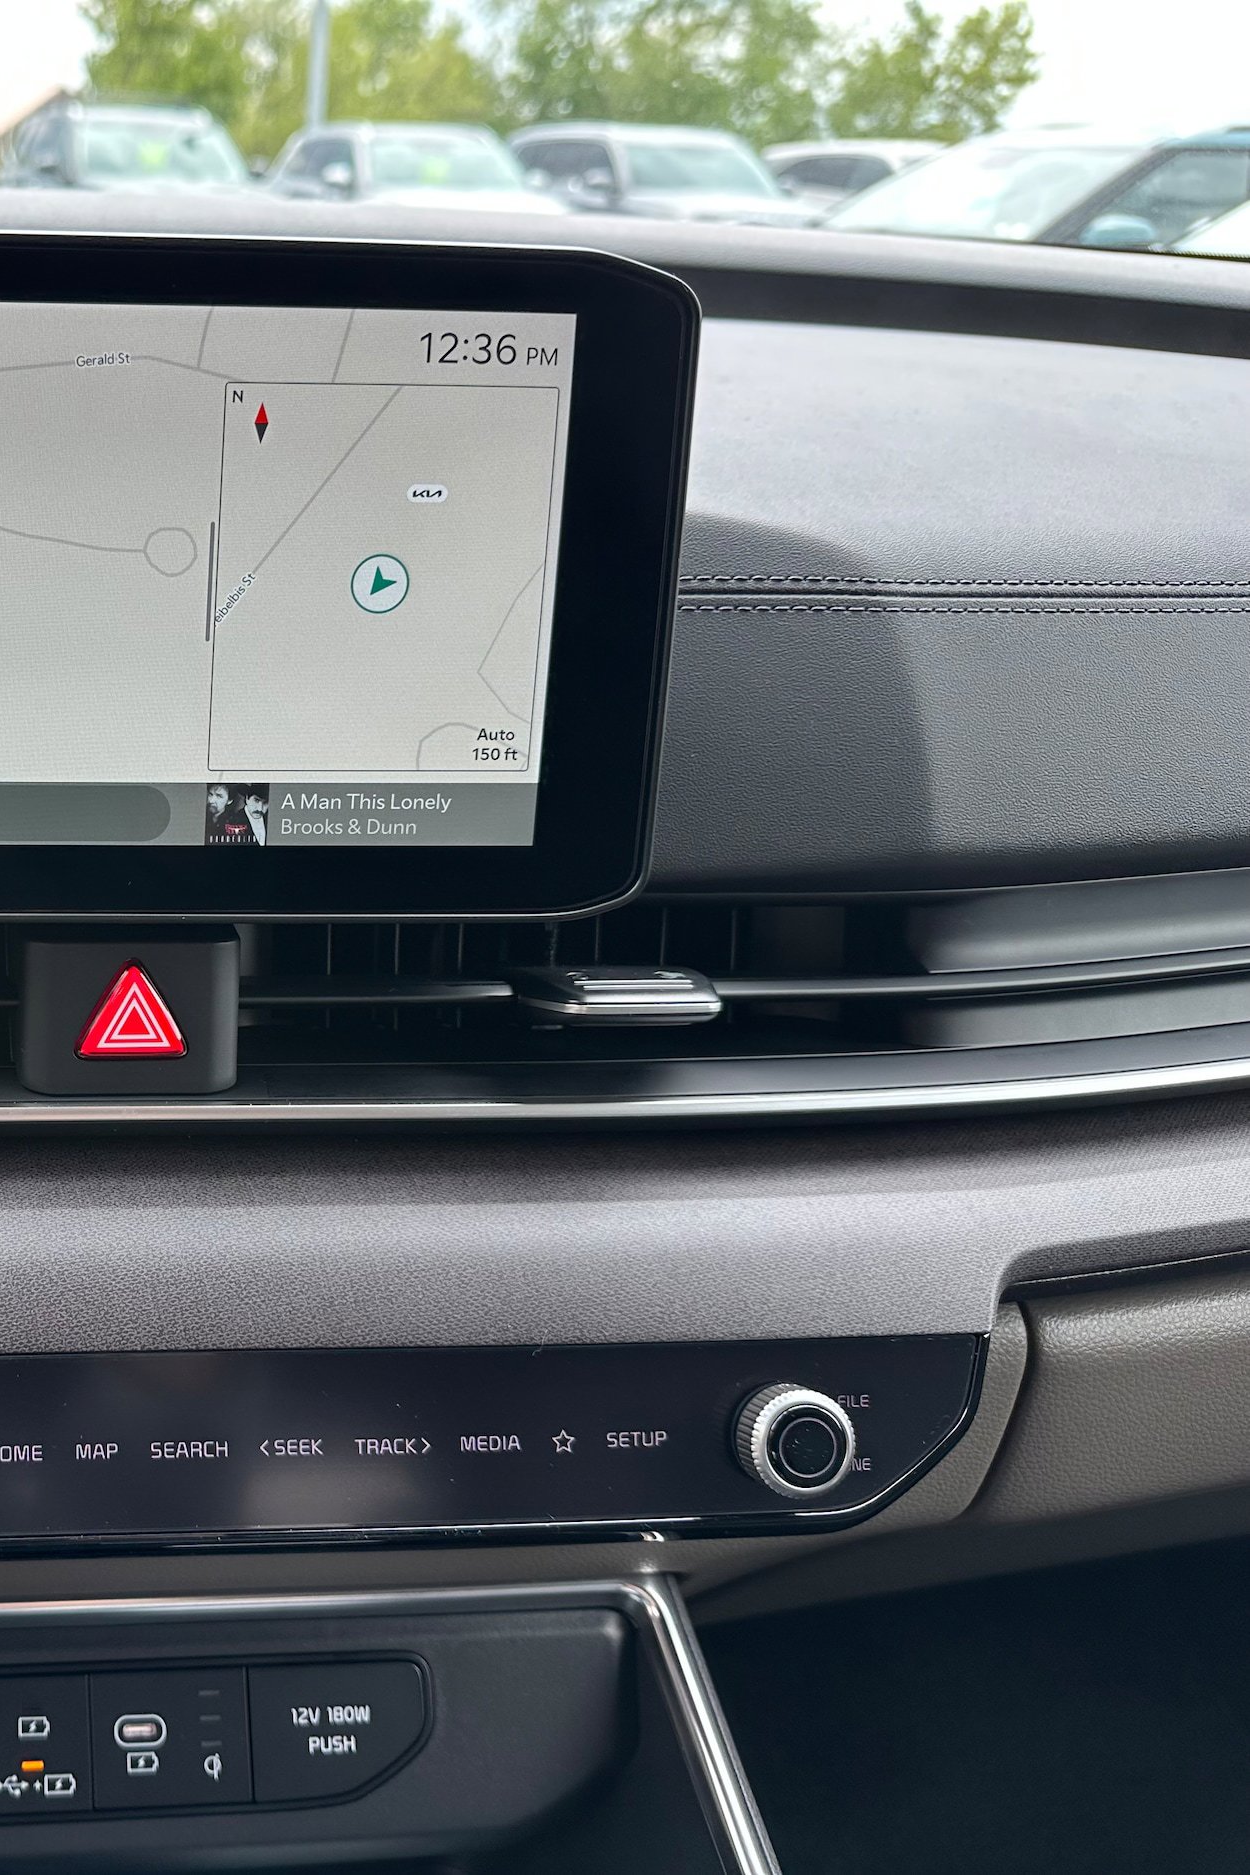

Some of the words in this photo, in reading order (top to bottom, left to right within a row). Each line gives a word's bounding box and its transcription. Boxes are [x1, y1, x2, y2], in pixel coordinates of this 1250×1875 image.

[420, 332, 517, 366] 12:36
[526, 347, 558, 366] PM
[76, 352, 116, 368] Gerald
[117, 352, 131, 364] St
[232, 390, 244, 404] N
[214, 585, 246, 624] eibelbis
[241, 573, 256, 587] St
[476, 727, 516, 742] Auto
[472, 747, 501, 761] 150
[504, 747, 518, 761] ft
[280, 793, 296, 810] A
[300, 793, 342, 810] Man
[346, 793, 386, 810] This
[390, 793, 452, 814] Lonely
[281, 818, 343, 835] Brooks
[347, 818, 362, 835] &
[366, 818, 417, 835] Dunn
[837, 1394, 870, 1408] FILE
[460, 1434, 521, 1452] MEDIA
[606, 1430, 667, 1448] SETUP
[75, 1443, 119, 1460] MAP
[150, 1440, 229, 1459] SEARCH
[851, 1457, 872, 1472] NE
[291, 1706, 321, 1726] 12V
[326, 1704, 371, 1724] 180W
[308, 1734, 357, 1754] PUSH
